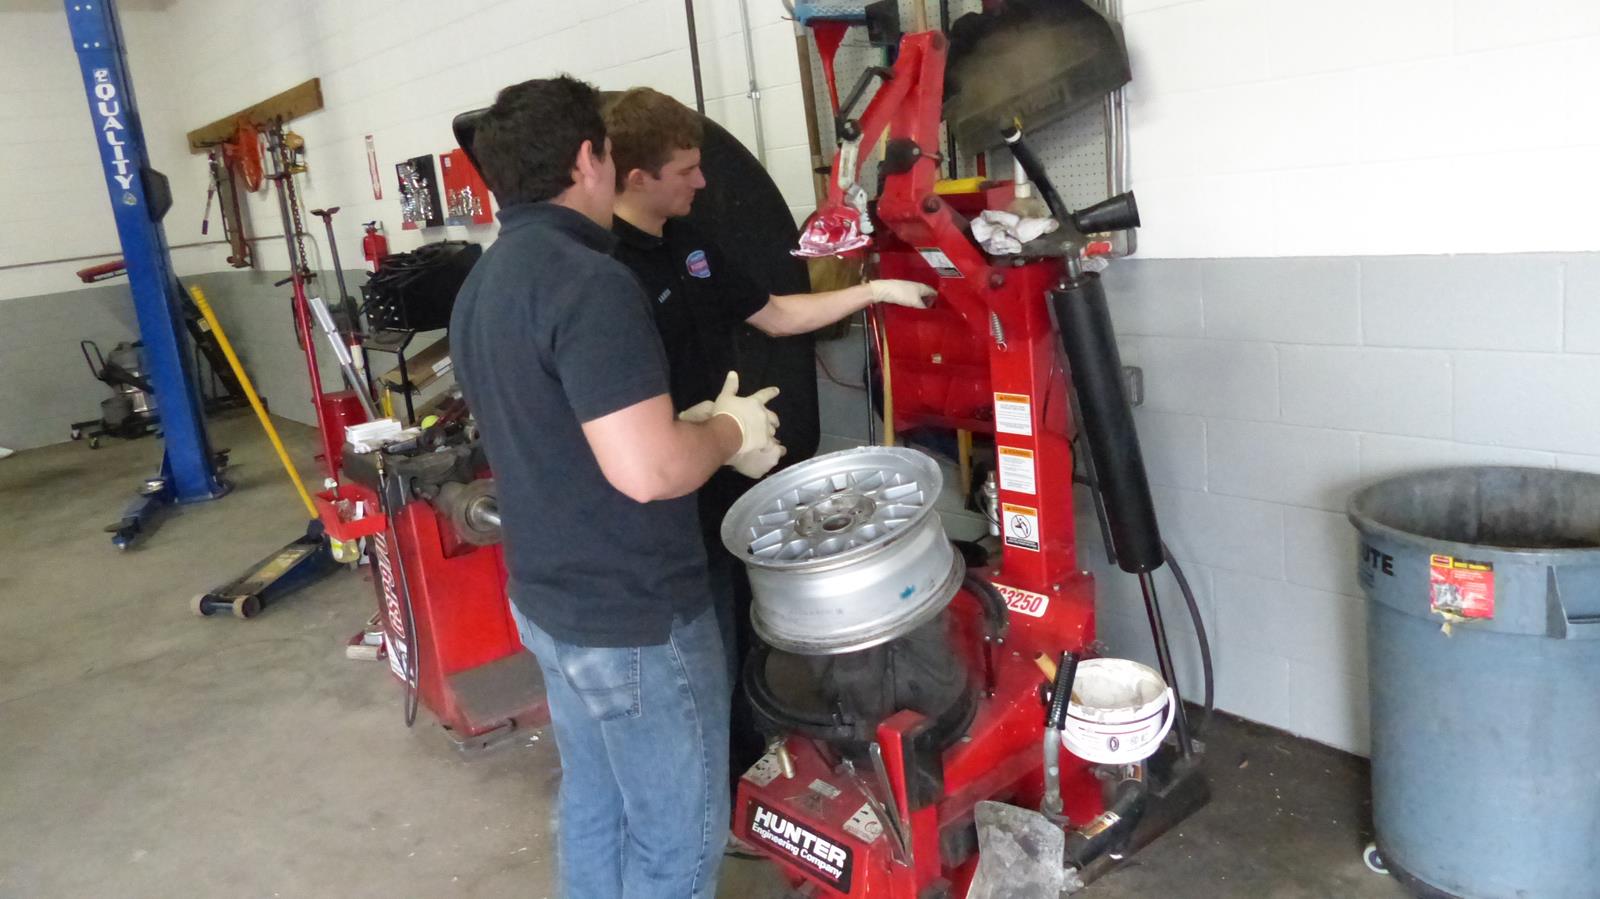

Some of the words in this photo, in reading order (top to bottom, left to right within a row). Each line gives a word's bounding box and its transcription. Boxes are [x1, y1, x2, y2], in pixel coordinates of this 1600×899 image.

[95, 83, 134, 189] QUALITY
[752, 823, 798, 856] Engineering
[800, 849, 842, 879] Company
[754, 806, 847, 868] HUNTER
